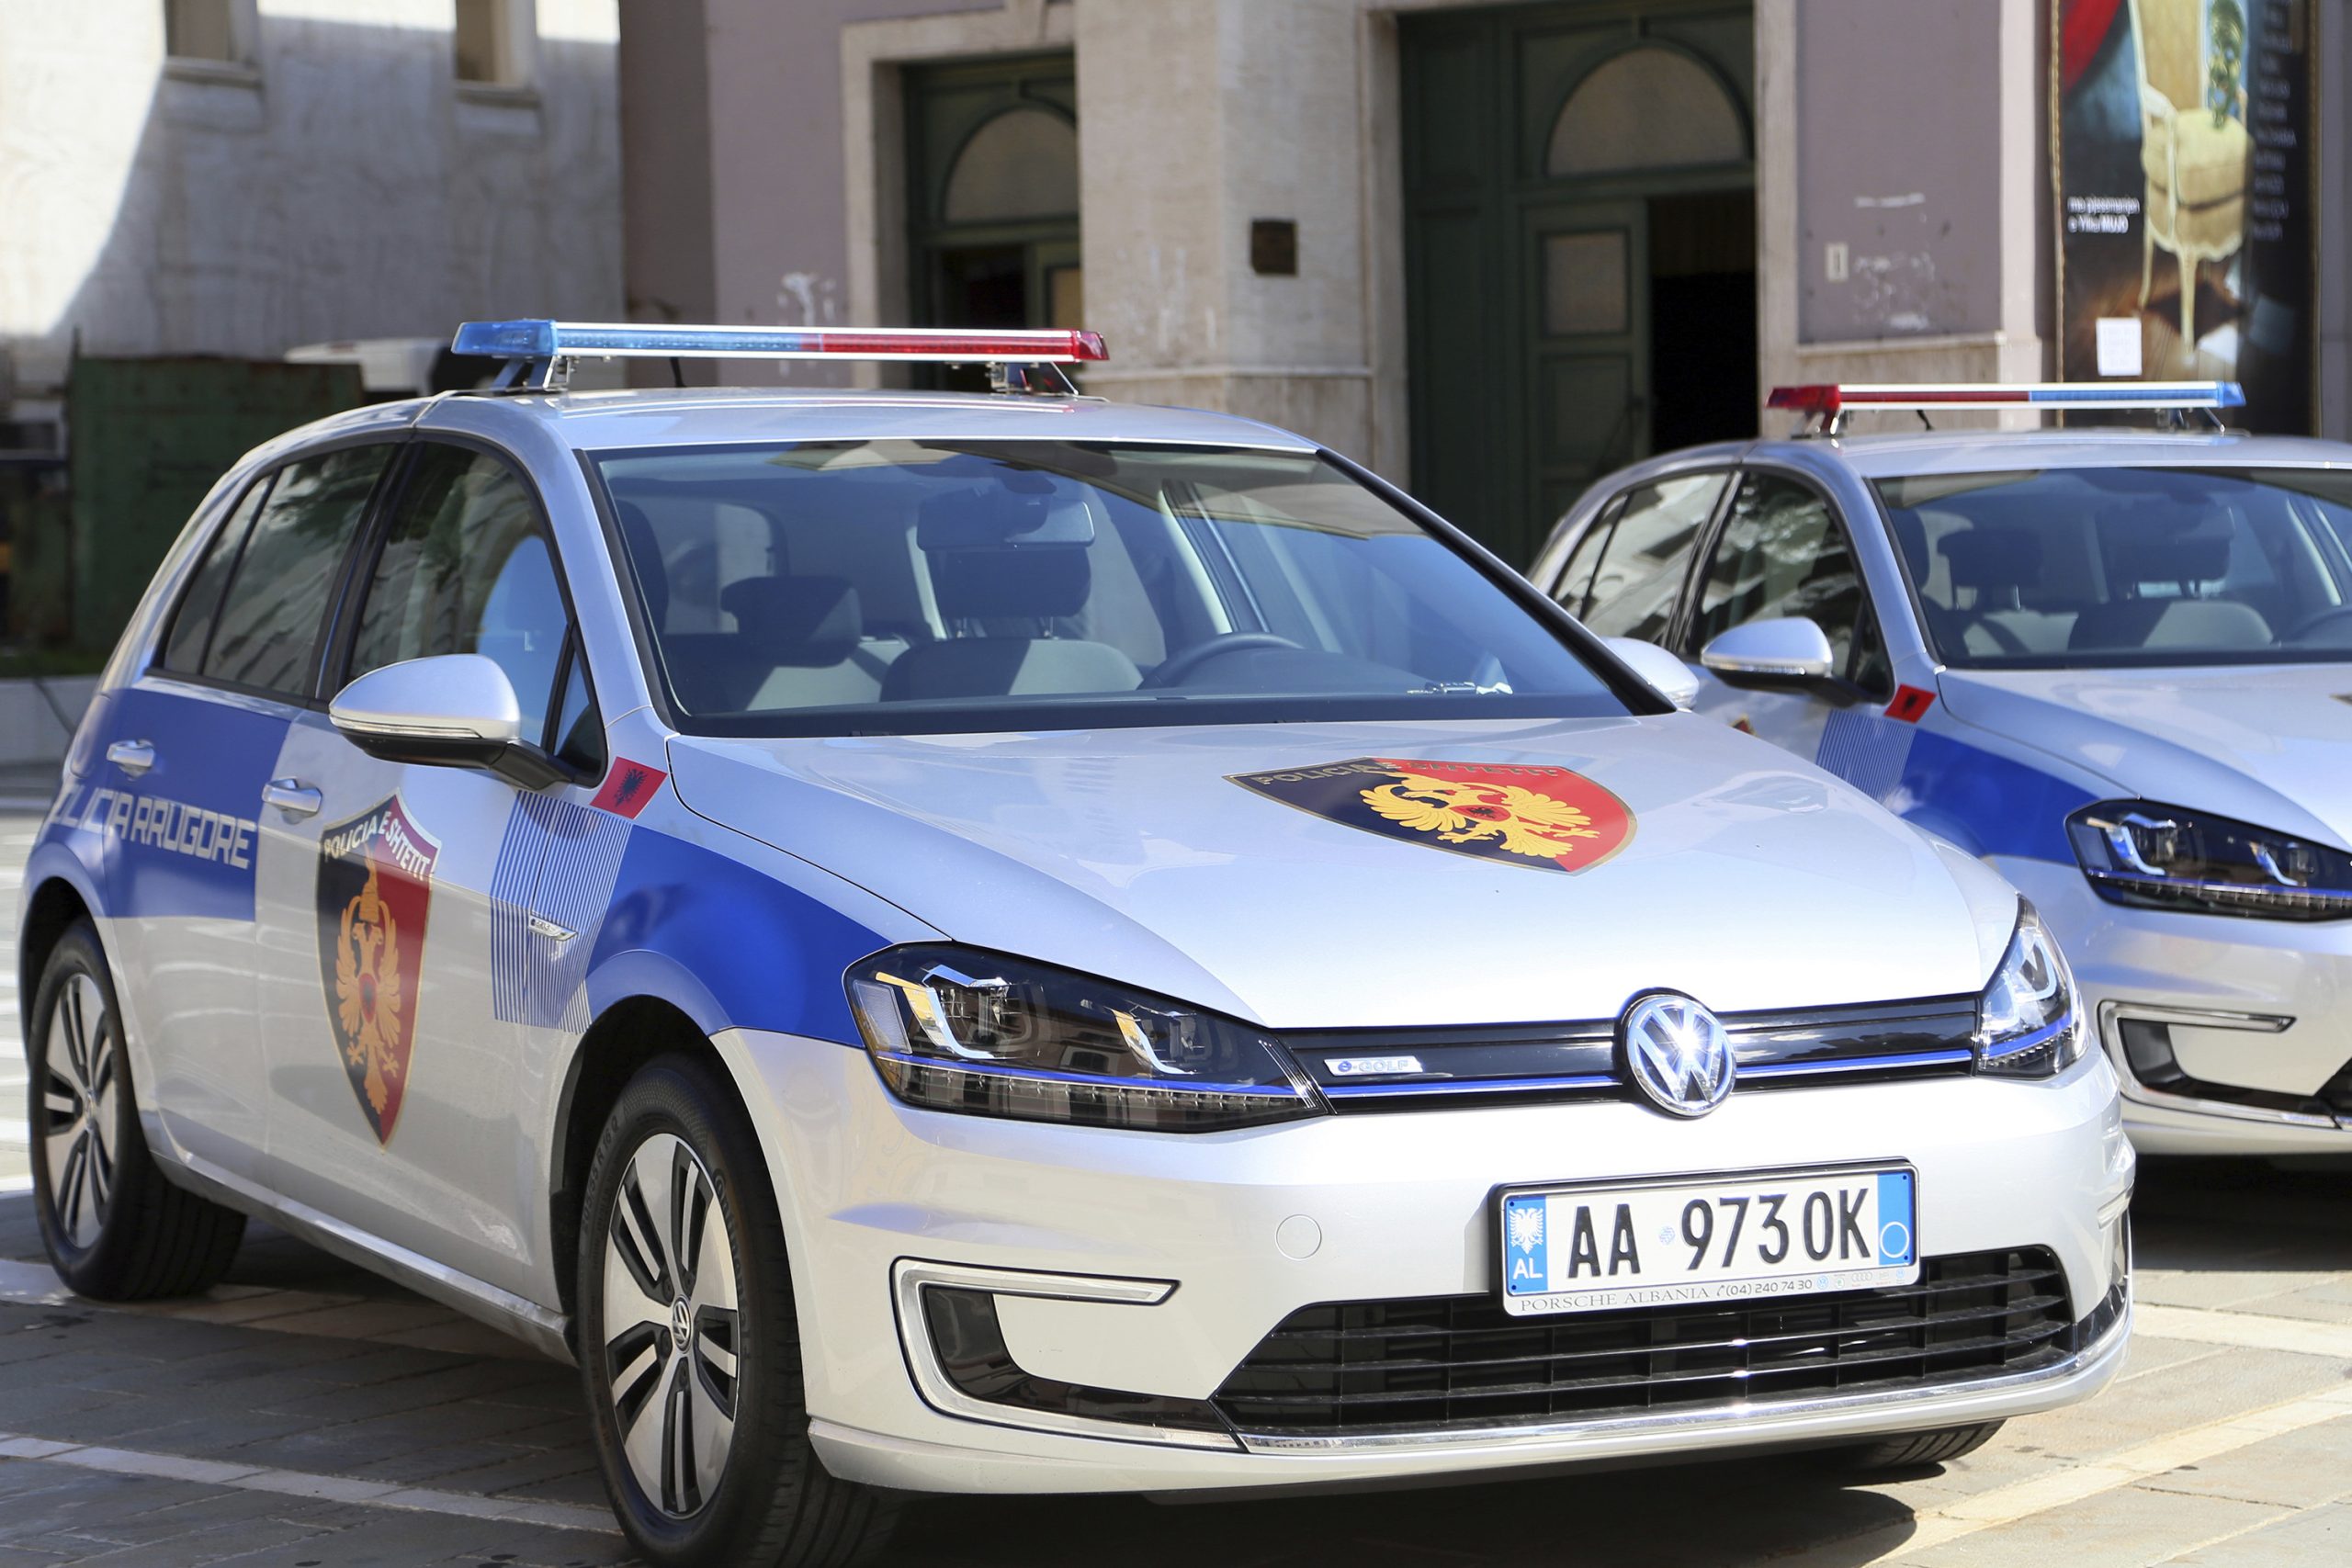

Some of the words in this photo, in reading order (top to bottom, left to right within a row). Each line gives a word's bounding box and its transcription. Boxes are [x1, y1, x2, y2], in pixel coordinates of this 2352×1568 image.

[1250, 762, 1371, 785] POLICIA
[130, 795, 258, 870] RRUGORE
[323, 814, 379, 863] POLICIA
[378, 810, 392, 835] E
[385, 818, 432, 882] SHTETIT
[1566, 1203, 1642, 1279] AA
[1512, 1258, 1544, 1280] AL
[1521, 1292, 1618, 1312] PORSCHE
[1623, 1287, 1710, 1305] ALBANIA
[1725, 1284, 1752, 1297] (04)
[1754, 1281, 1779, 1293] 240
[1781, 1280, 1795, 1292] 74
[1797, 1279, 1814, 1291] 30
